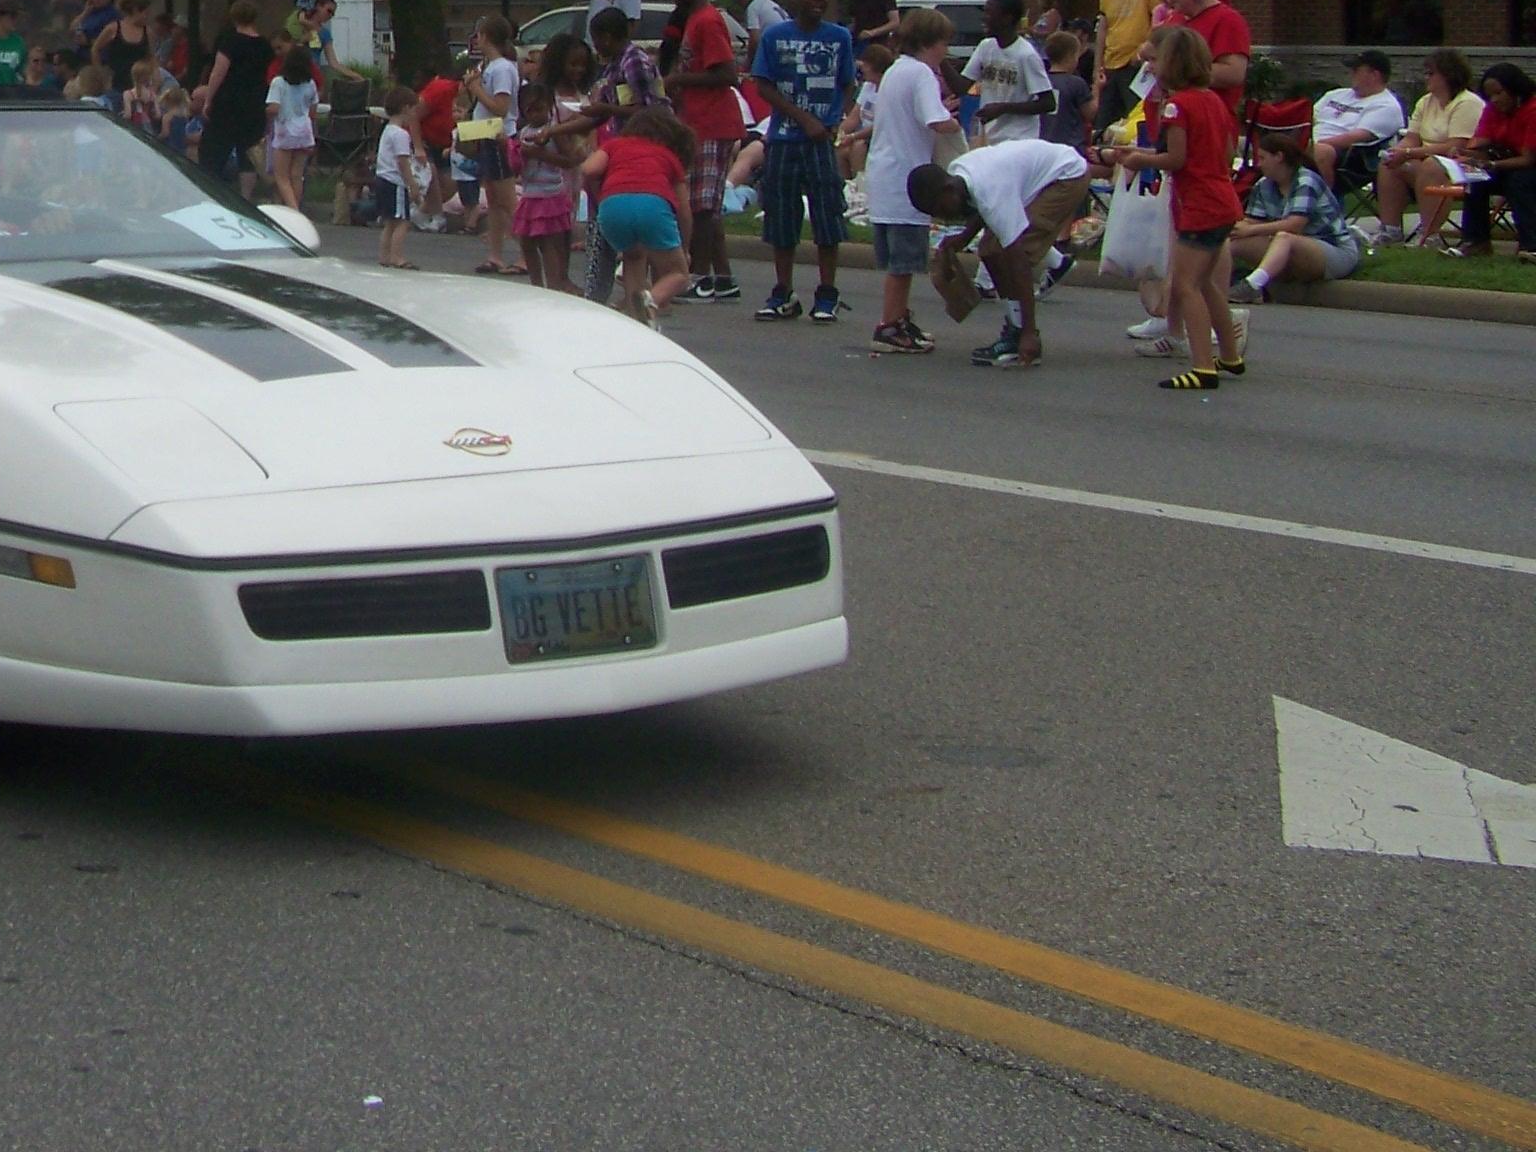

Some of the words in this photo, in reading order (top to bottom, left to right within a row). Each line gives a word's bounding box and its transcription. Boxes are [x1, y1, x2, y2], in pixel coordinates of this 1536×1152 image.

[211, 217, 268, 240] 56
[511, 595, 548, 640] BG
[556, 585, 644, 636] VETTE
